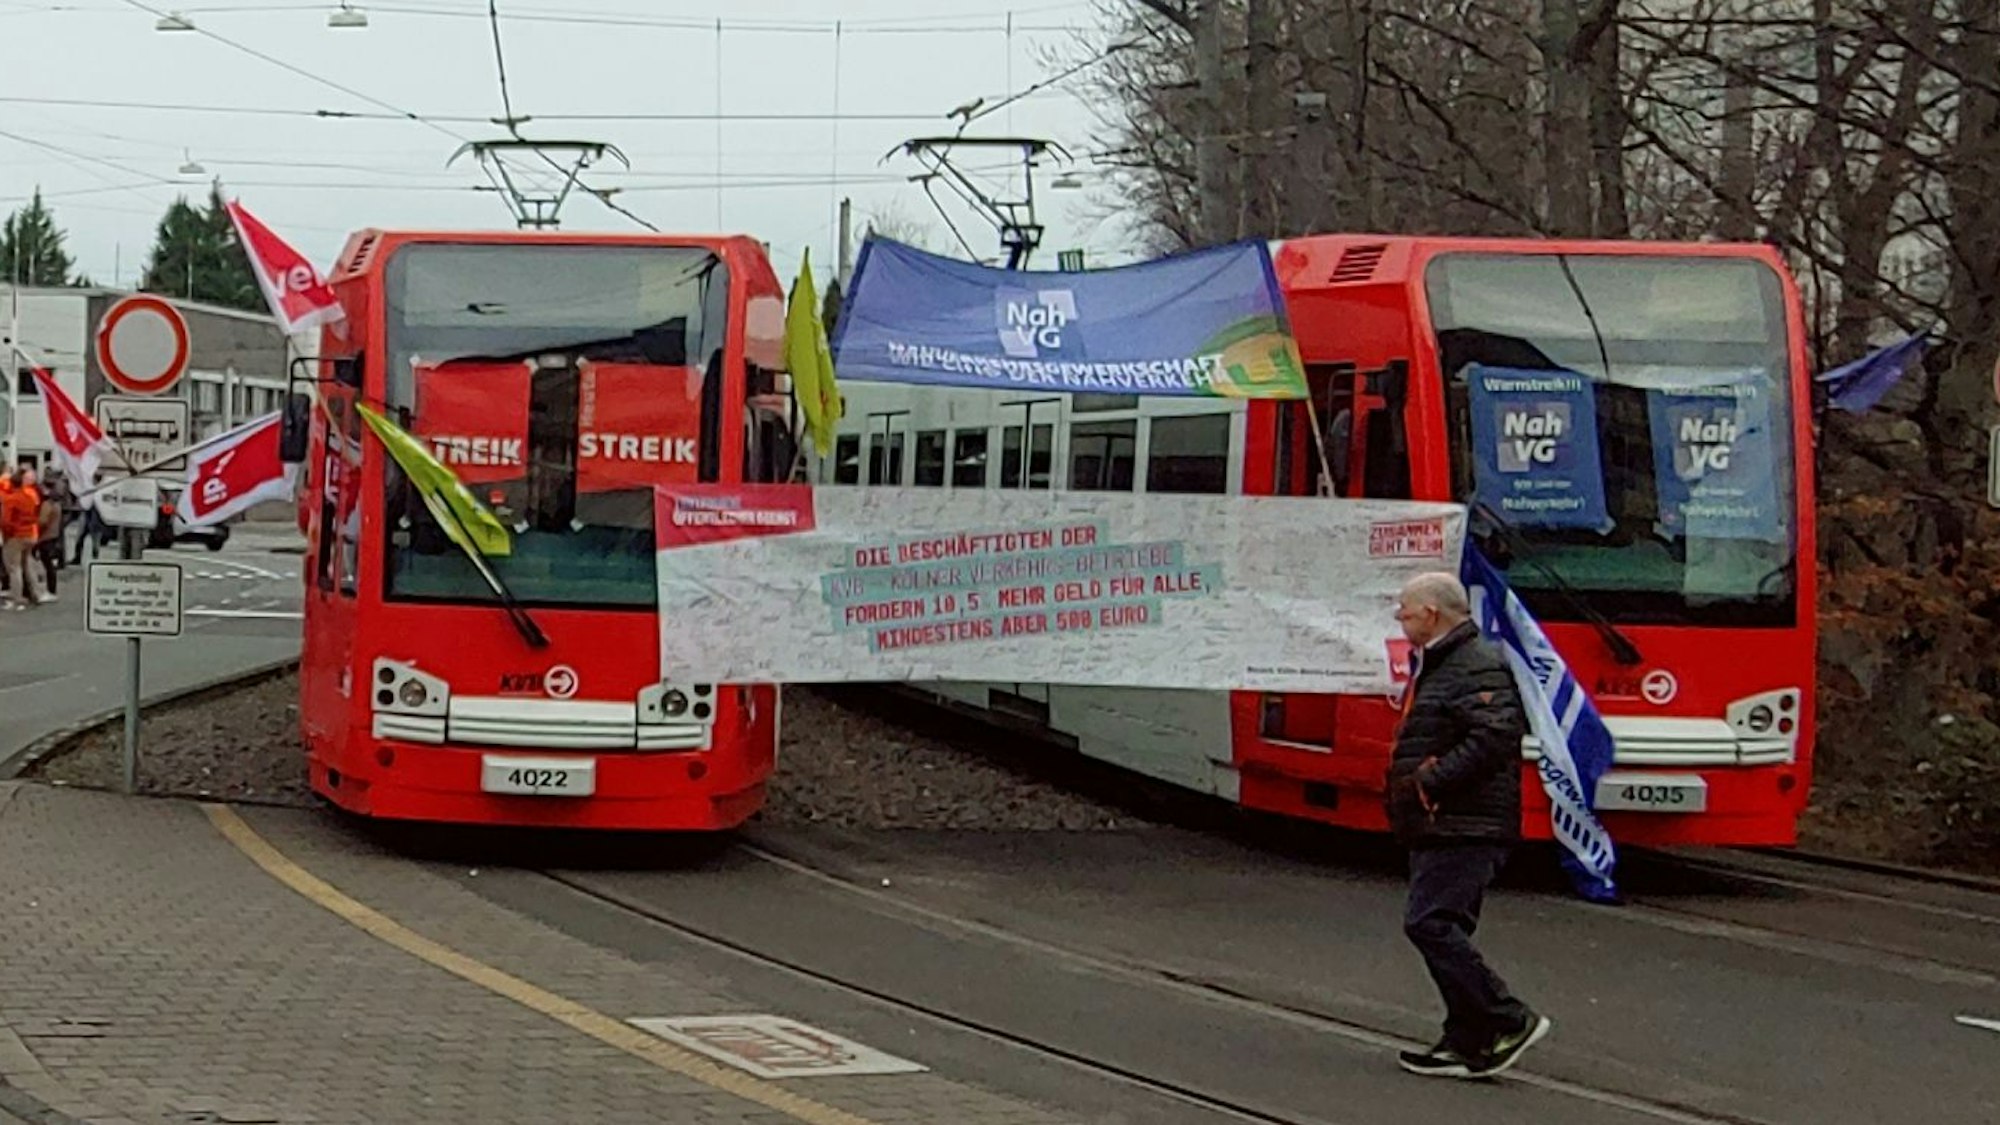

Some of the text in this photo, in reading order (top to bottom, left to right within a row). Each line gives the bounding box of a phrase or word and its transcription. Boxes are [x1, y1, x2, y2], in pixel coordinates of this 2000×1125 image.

[1007, 302, 1066, 328] Nah
[1018, 328, 1060, 348] VG
[1504, 410, 1562, 437] Nah
[1680, 417, 1736, 442] Nah
[580, 433, 696, 463] STREIK
[1515, 439, 1556, 462] VG
[1690, 445, 1730, 470] VG
[855, 525, 1096, 568] DIE BESCHÄFTIGTEN DER
[891, 567, 962, 590] KÖLNER
[845, 598, 925, 626] FORDERN
[997, 585, 1046, 608] MEHR
[1053, 579, 1101, 602] GELD
[1109, 574, 1145, 596] FÜR
[1153, 571, 1212, 596] ALLE,
[876, 620, 994, 650] MINDESTENS
[1001, 614, 1048, 636] ABER
[1099, 604, 1148, 627] EURO
[508, 769, 568, 788] 4022
[1622, 785, 1685, 804] 4035
